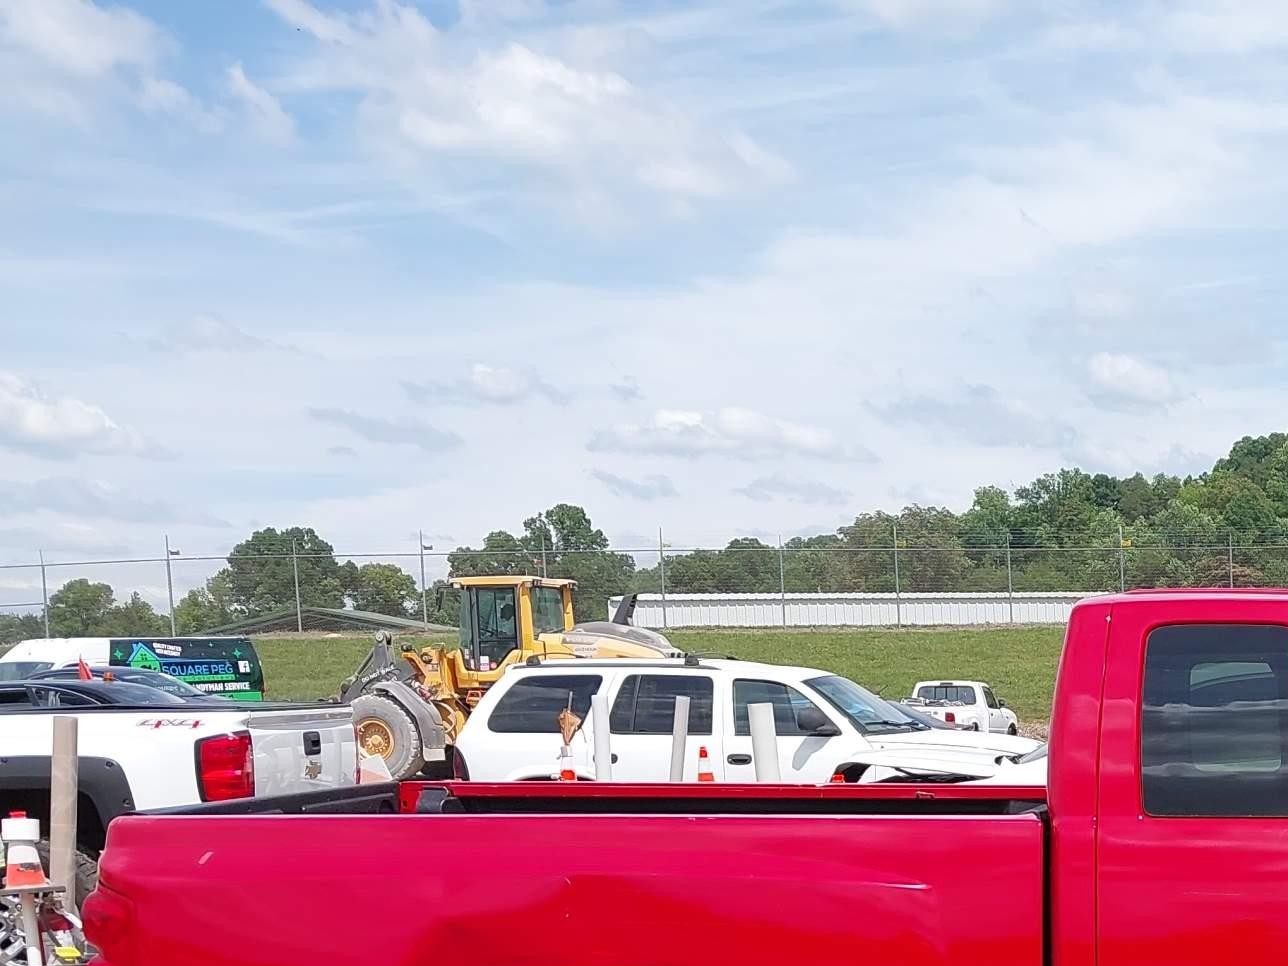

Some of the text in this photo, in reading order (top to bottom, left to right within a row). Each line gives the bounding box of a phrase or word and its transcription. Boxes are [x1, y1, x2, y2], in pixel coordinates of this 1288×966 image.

[162, 663, 233, 676] SQUARE PEG
[224, 681, 251, 691] SERVICE
